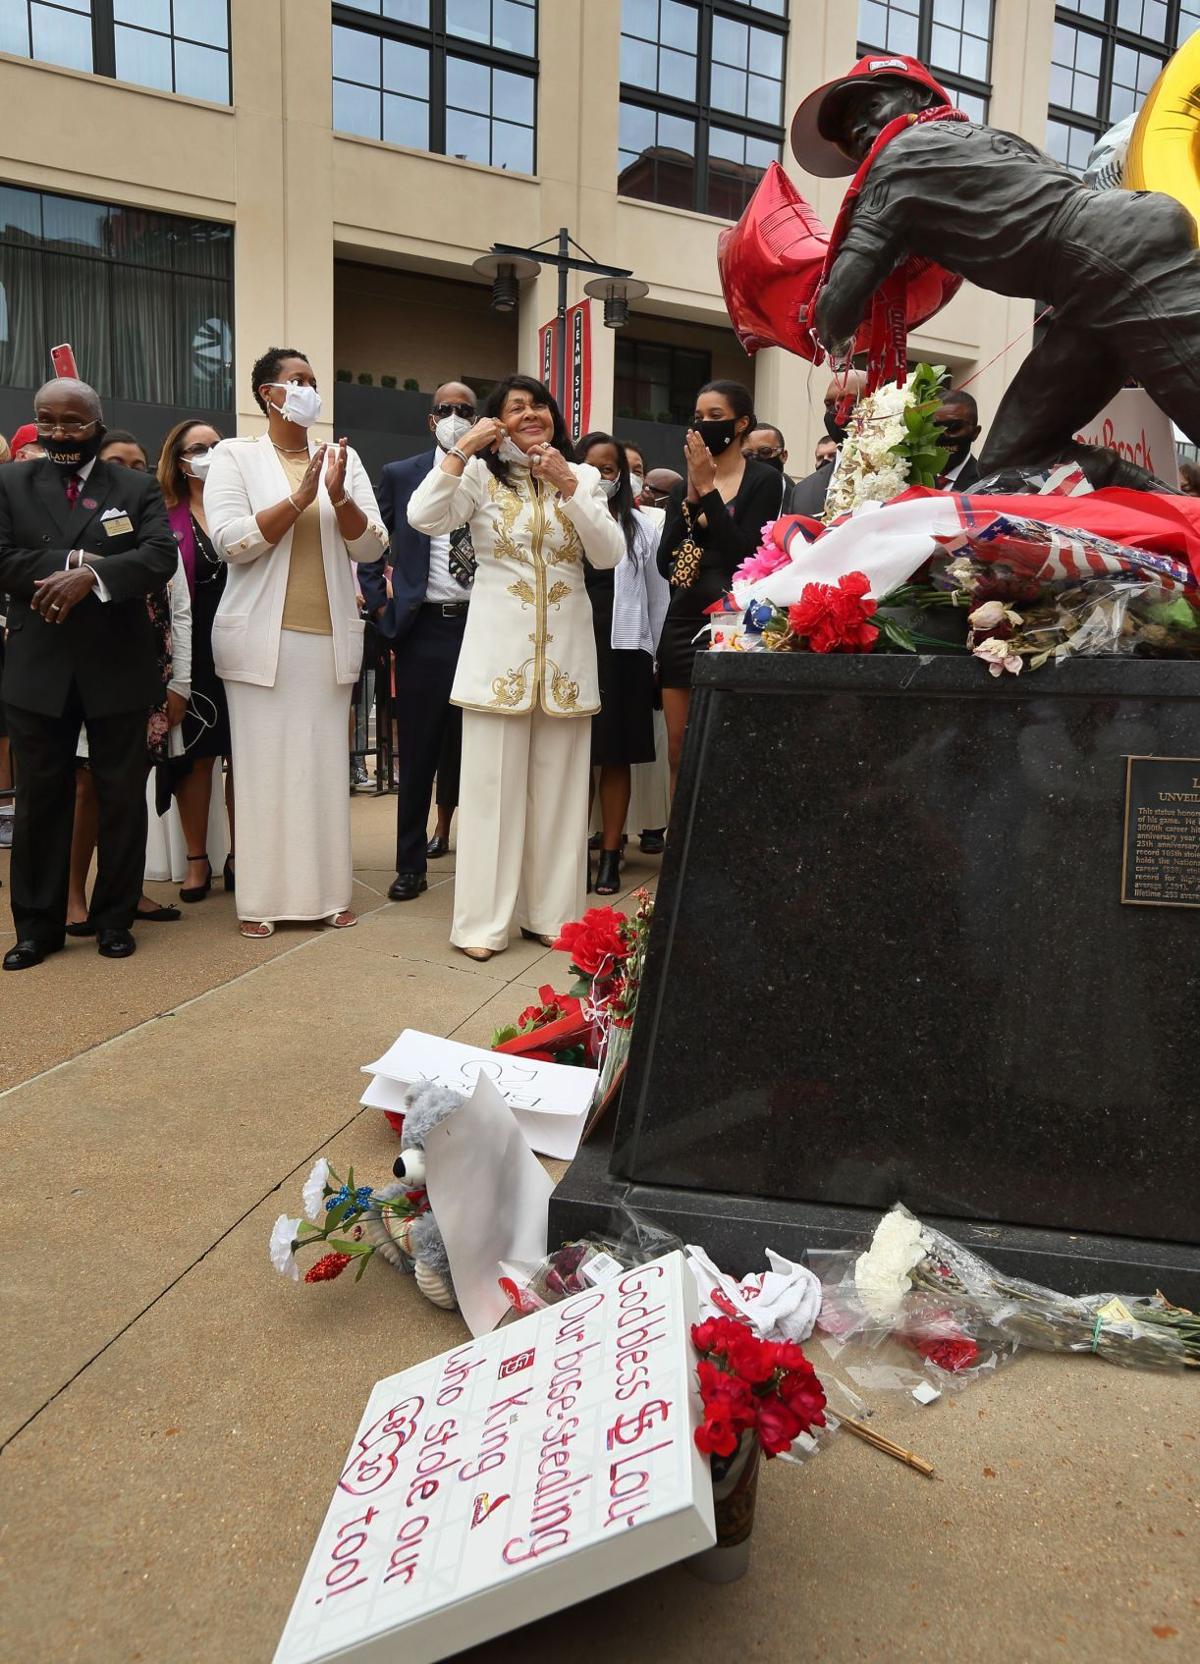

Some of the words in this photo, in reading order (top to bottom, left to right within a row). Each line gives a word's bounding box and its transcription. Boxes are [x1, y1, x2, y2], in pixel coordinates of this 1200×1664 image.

[573, 375, 581, 436] STORE
[1136, 832, 1177, 842] anniversary
[554, 1292, 605, 1345] Our
[405, 1418, 462, 1508] stole
[458, 1386, 535, 1482] King
[314, 1505, 381, 1606] too!
[383, 1515, 430, 1585] our
